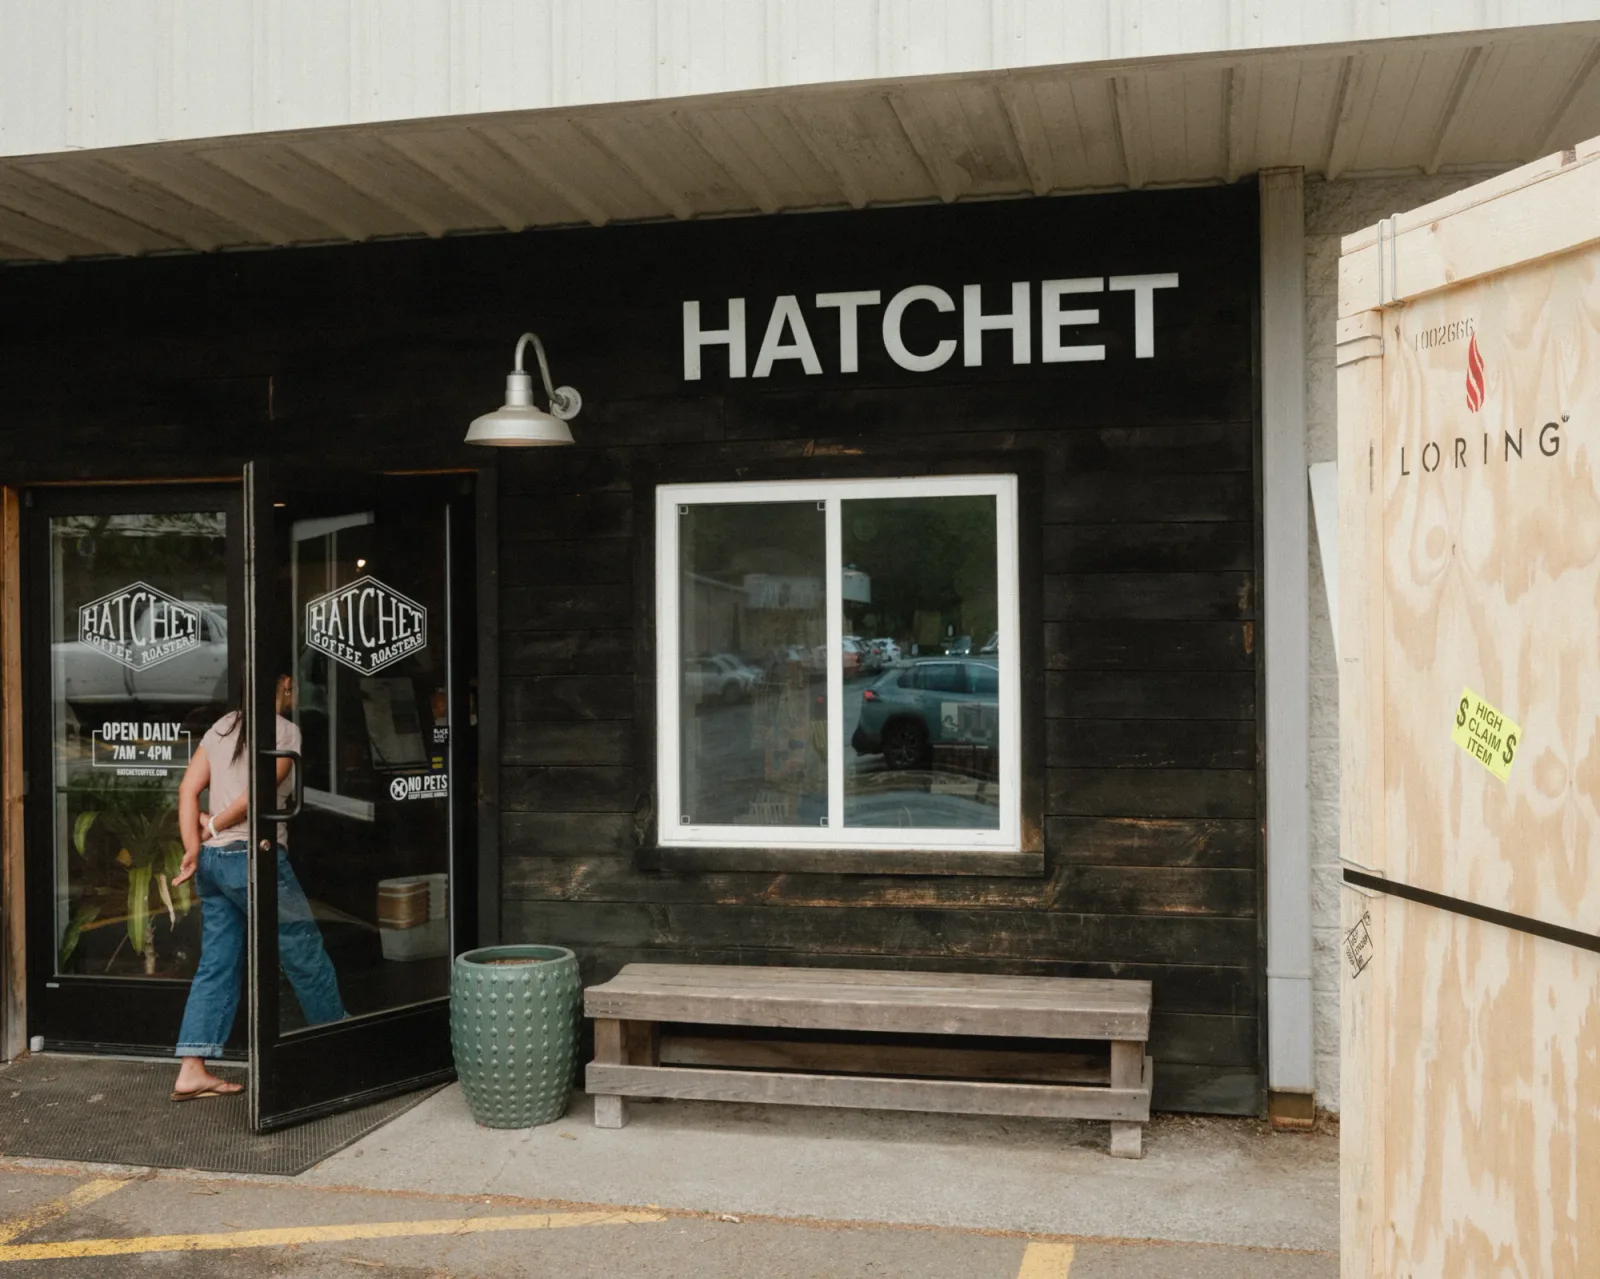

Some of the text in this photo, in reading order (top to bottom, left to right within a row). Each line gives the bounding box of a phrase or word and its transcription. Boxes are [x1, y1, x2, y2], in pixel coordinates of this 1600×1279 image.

[683, 272, 1179, 381] HATCHET
[1415, 317, 1474, 352] 1002666
[1401, 422, 1560, 476] LORING
[83, 592, 196, 646] HATCHET
[311, 588, 422, 648] HATCHET
[86, 632, 196, 664] COFFEE ROASTERS
[313, 633, 422, 667] COFFEE ROASTERS
[102, 722, 181, 742] OPEN DAILY
[1475, 702, 1503, 732] HIGH
[1467, 736, 1493, 766] ITEM
[1468, 717, 1502, 752] CLAIM
[112, 745, 136, 760] 7AM
[147, 745, 172, 760] 4PM
[117, 768, 168, 776] HATCHETCOFFEE.COM
[408, 774, 448, 791] NO PETS
